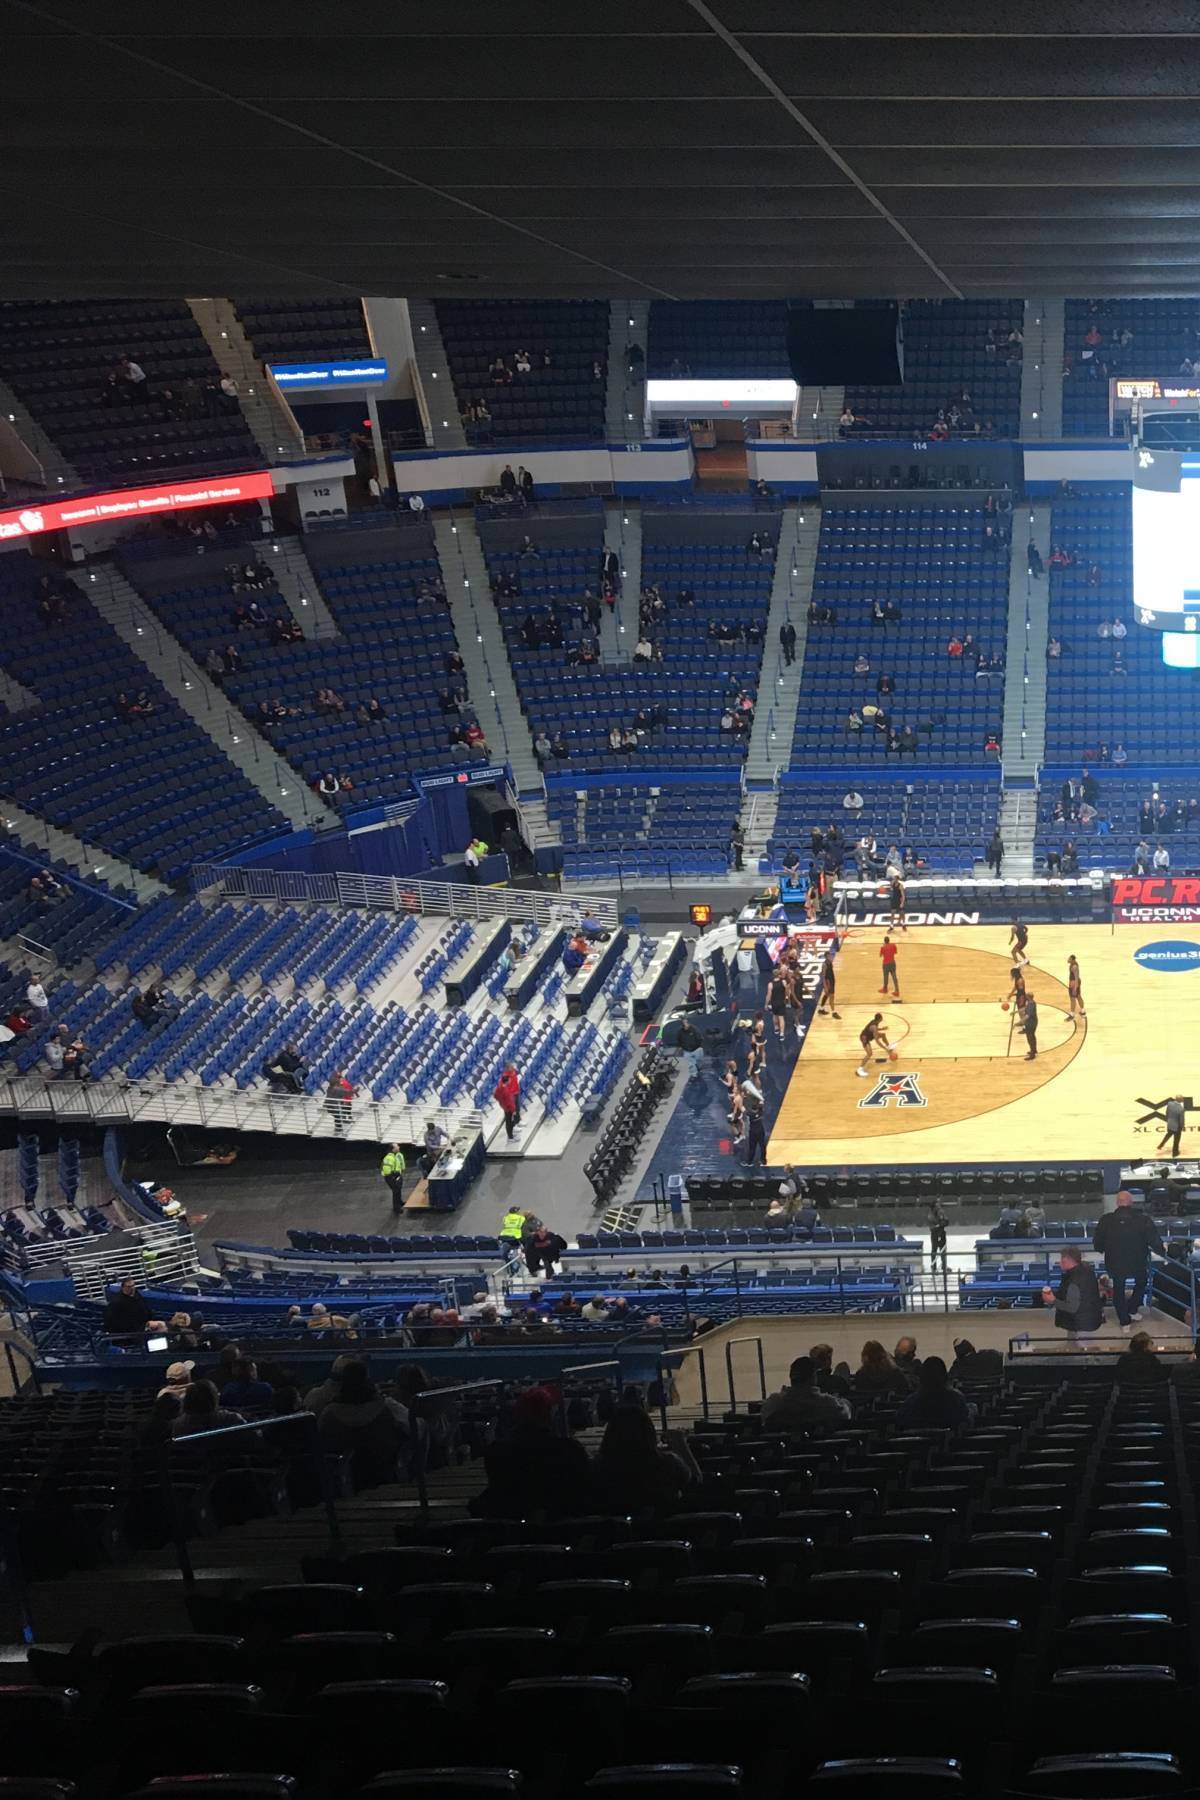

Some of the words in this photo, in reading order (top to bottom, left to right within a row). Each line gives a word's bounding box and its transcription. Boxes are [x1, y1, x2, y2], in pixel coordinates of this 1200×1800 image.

[313, 488, 330, 496] 112
[1121, 907, 1200, 917] UCONN
[744, 925, 780, 933] UCONN
